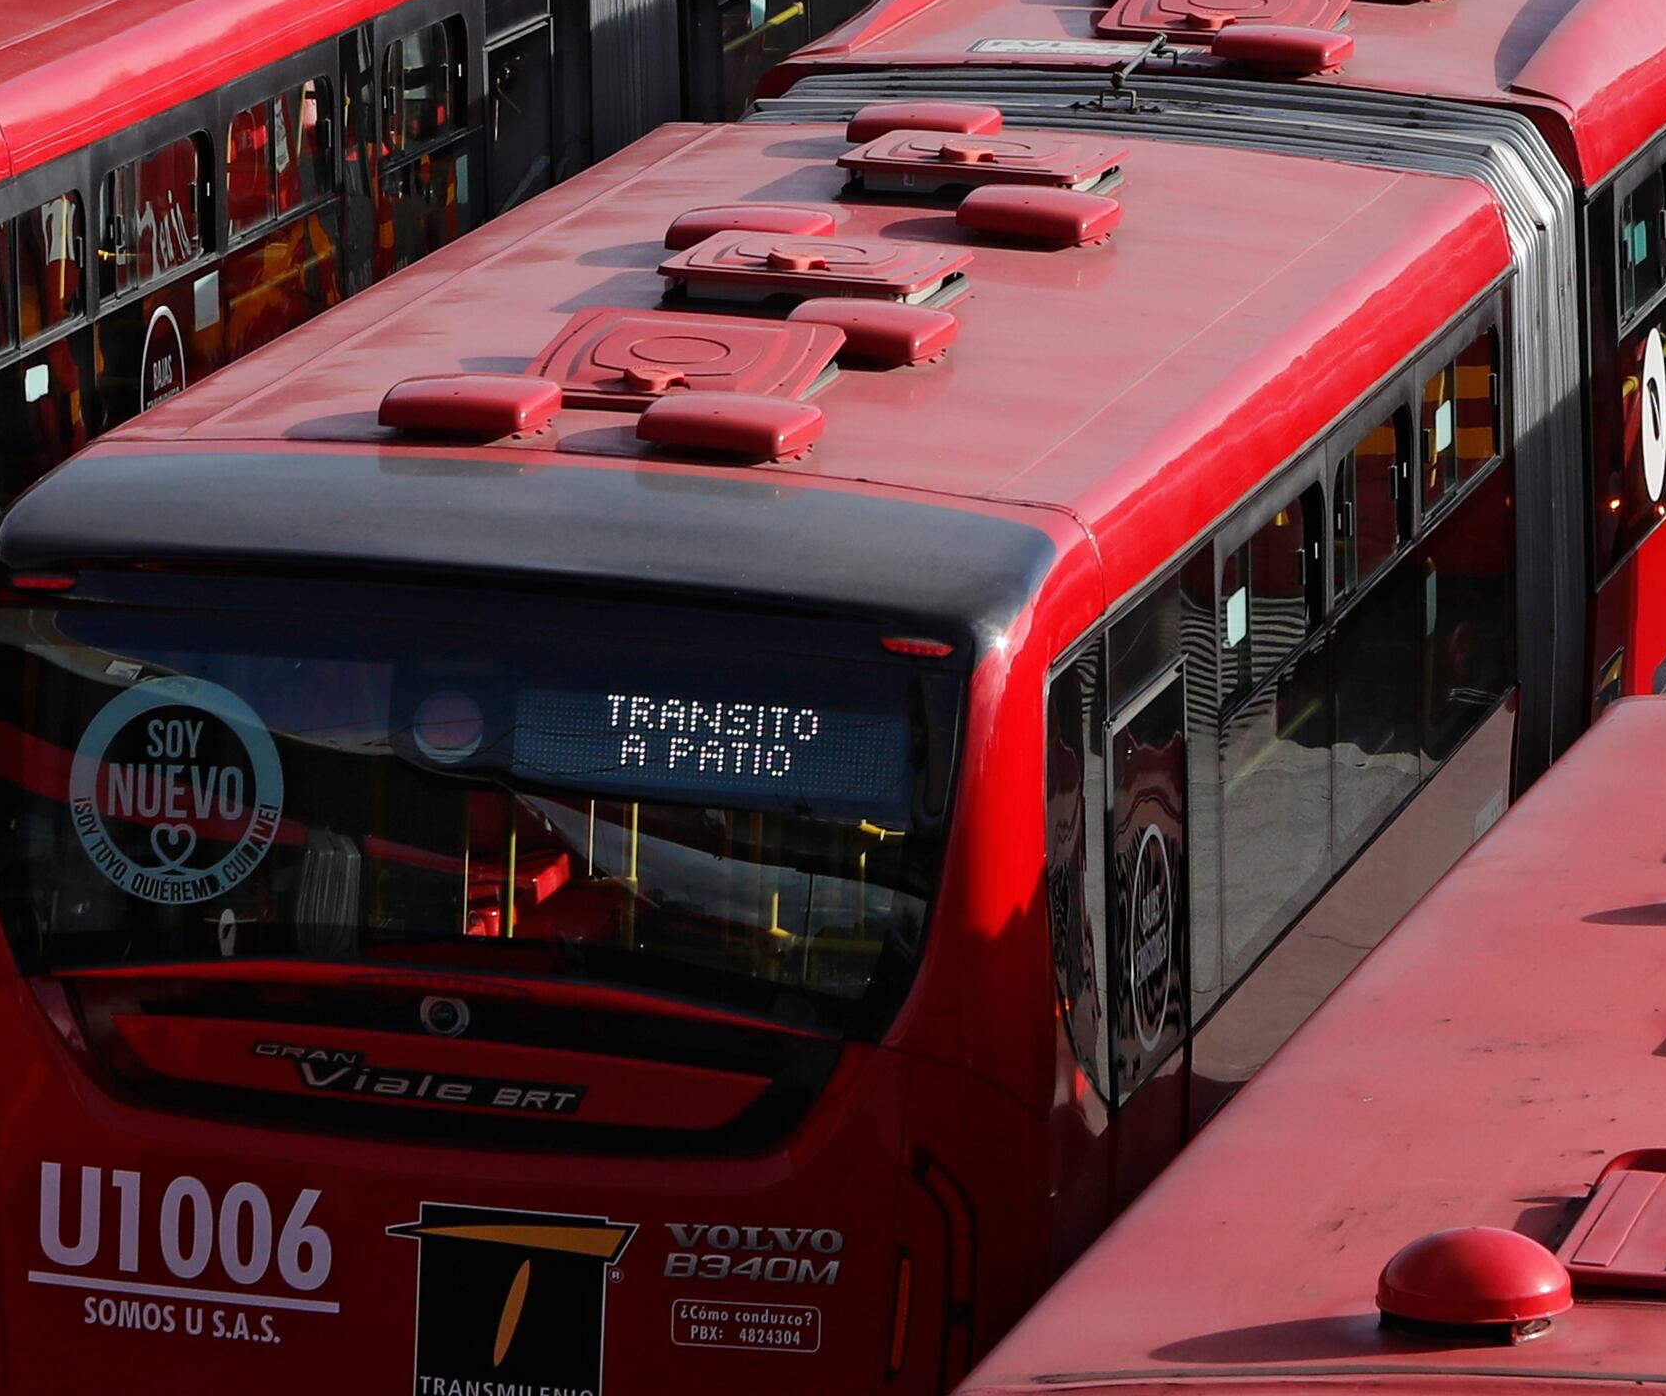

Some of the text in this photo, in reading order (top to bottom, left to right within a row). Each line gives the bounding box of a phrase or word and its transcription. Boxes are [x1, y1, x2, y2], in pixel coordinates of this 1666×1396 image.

[606, 694, 819, 741] TRANSITO
[146, 719, 204, 759] SOY
[620, 733, 791, 777] A PATIO
[107, 762, 244, 821] NUEVO
[131, 872, 226, 902] QUIÉREM,
[254, 1043, 357, 1064] GRAN
[300, 1061, 577, 1111] Viale BRT
[39, 1161, 333, 1291] U1006
[663, 1222, 844, 1254] VOLVO
[662, 1253, 841, 1285] B340M
[84, 1296, 281, 1344] SOMOS U S.A.S.
[680, 1303, 813, 1327] ¿Cómo conduzco?
[690, 1325, 802, 1346] PBX: 4824304
